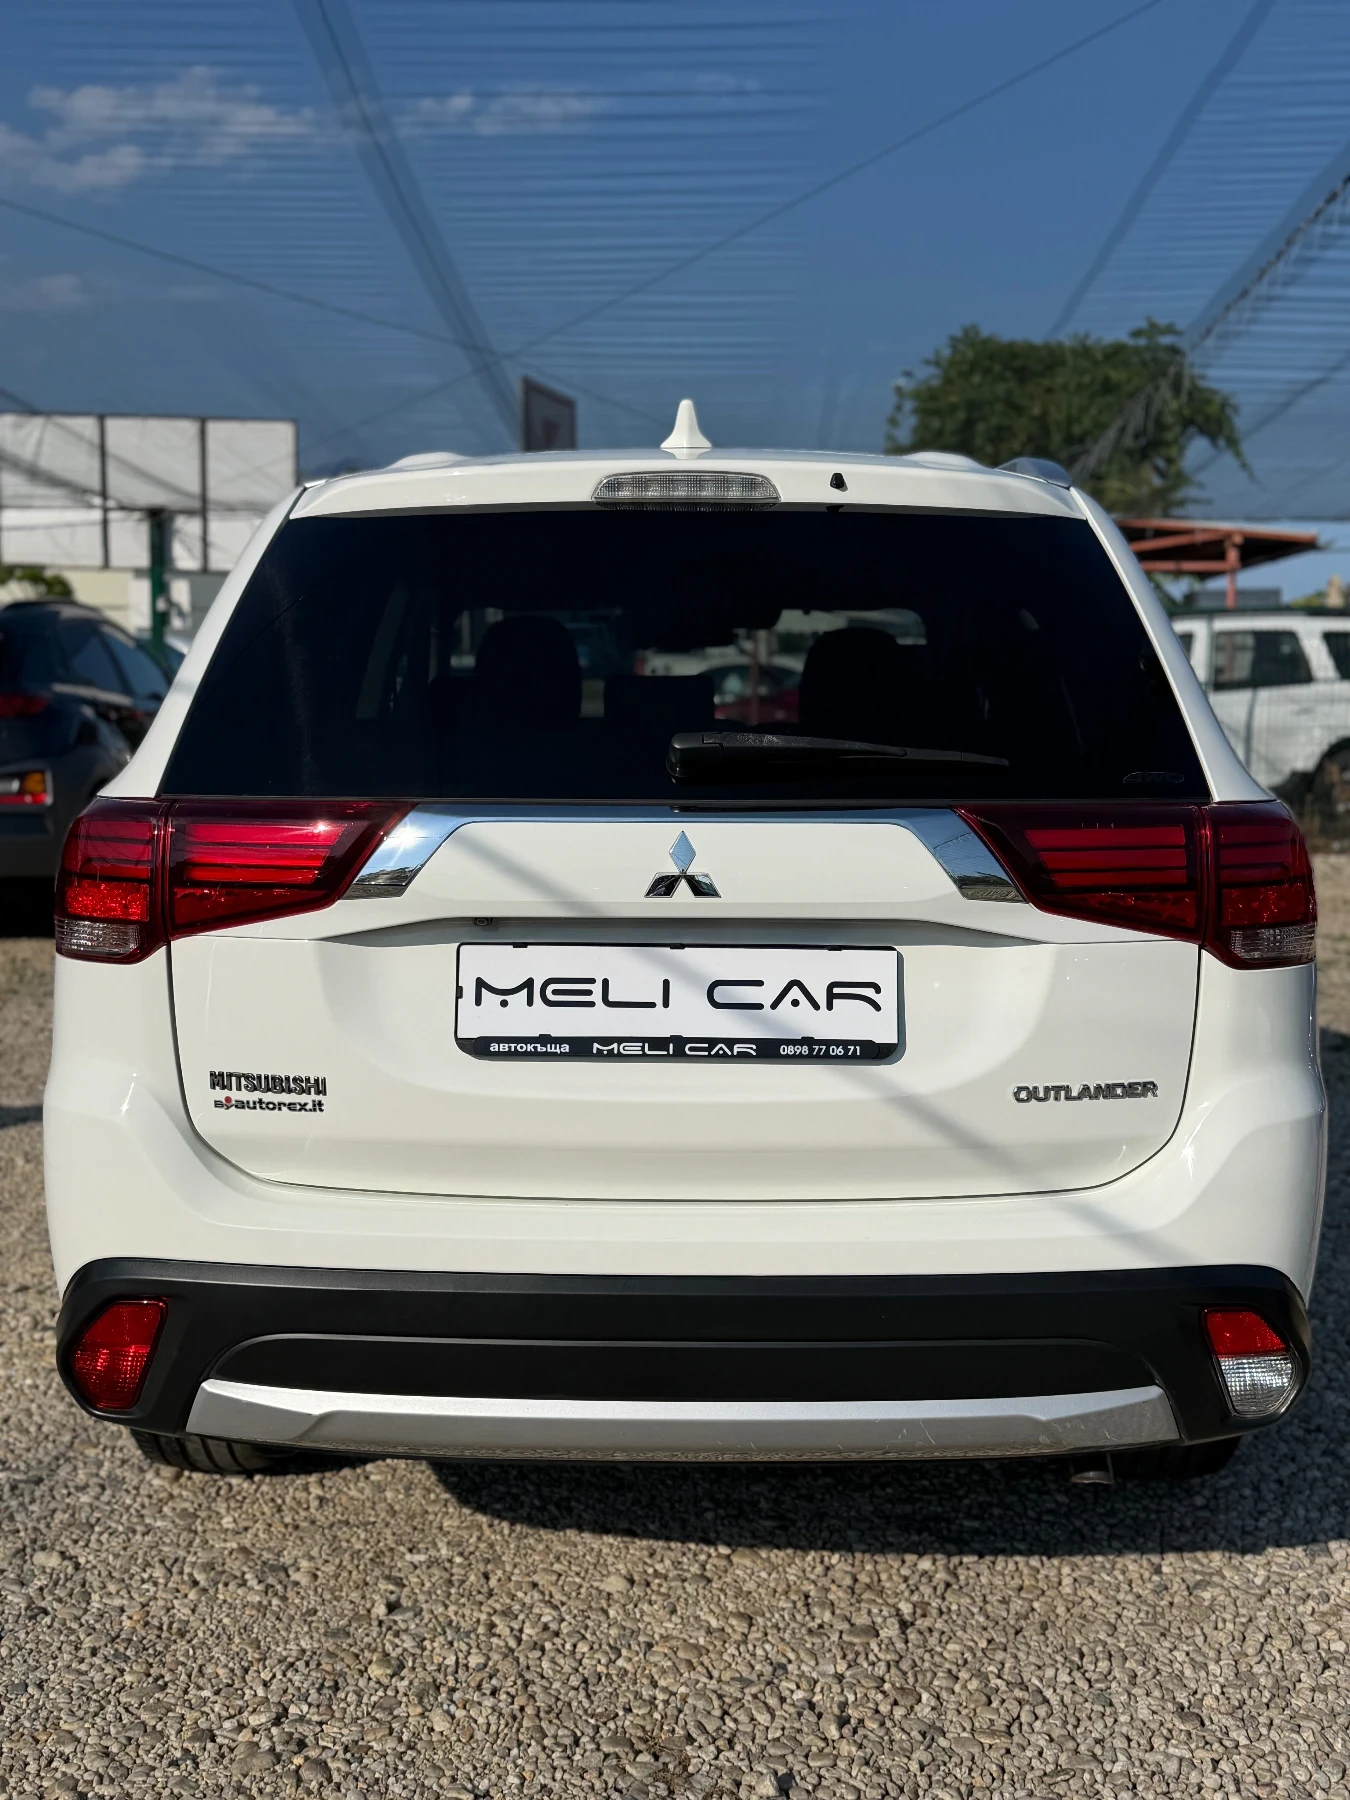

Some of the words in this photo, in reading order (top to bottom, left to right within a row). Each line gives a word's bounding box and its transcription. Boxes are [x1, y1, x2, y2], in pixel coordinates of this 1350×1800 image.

[474, 977, 670, 1009] MELI
[706, 979, 882, 1012] CAR
[489, 1042, 570, 1054] автокъща
[592, 1042, 674, 1055] MELI
[684, 1043, 757, 1056] CAR
[779, 1045, 809, 1056] 0898
[812, 1045, 827, 1056] 77
[829, 1045, 844, 1056] 06
[847, 1045, 861, 1056] 71
[209, 1070, 327, 1096] MITSUBISHI
[1013, 1080, 1159, 1103] OUTLANDER
